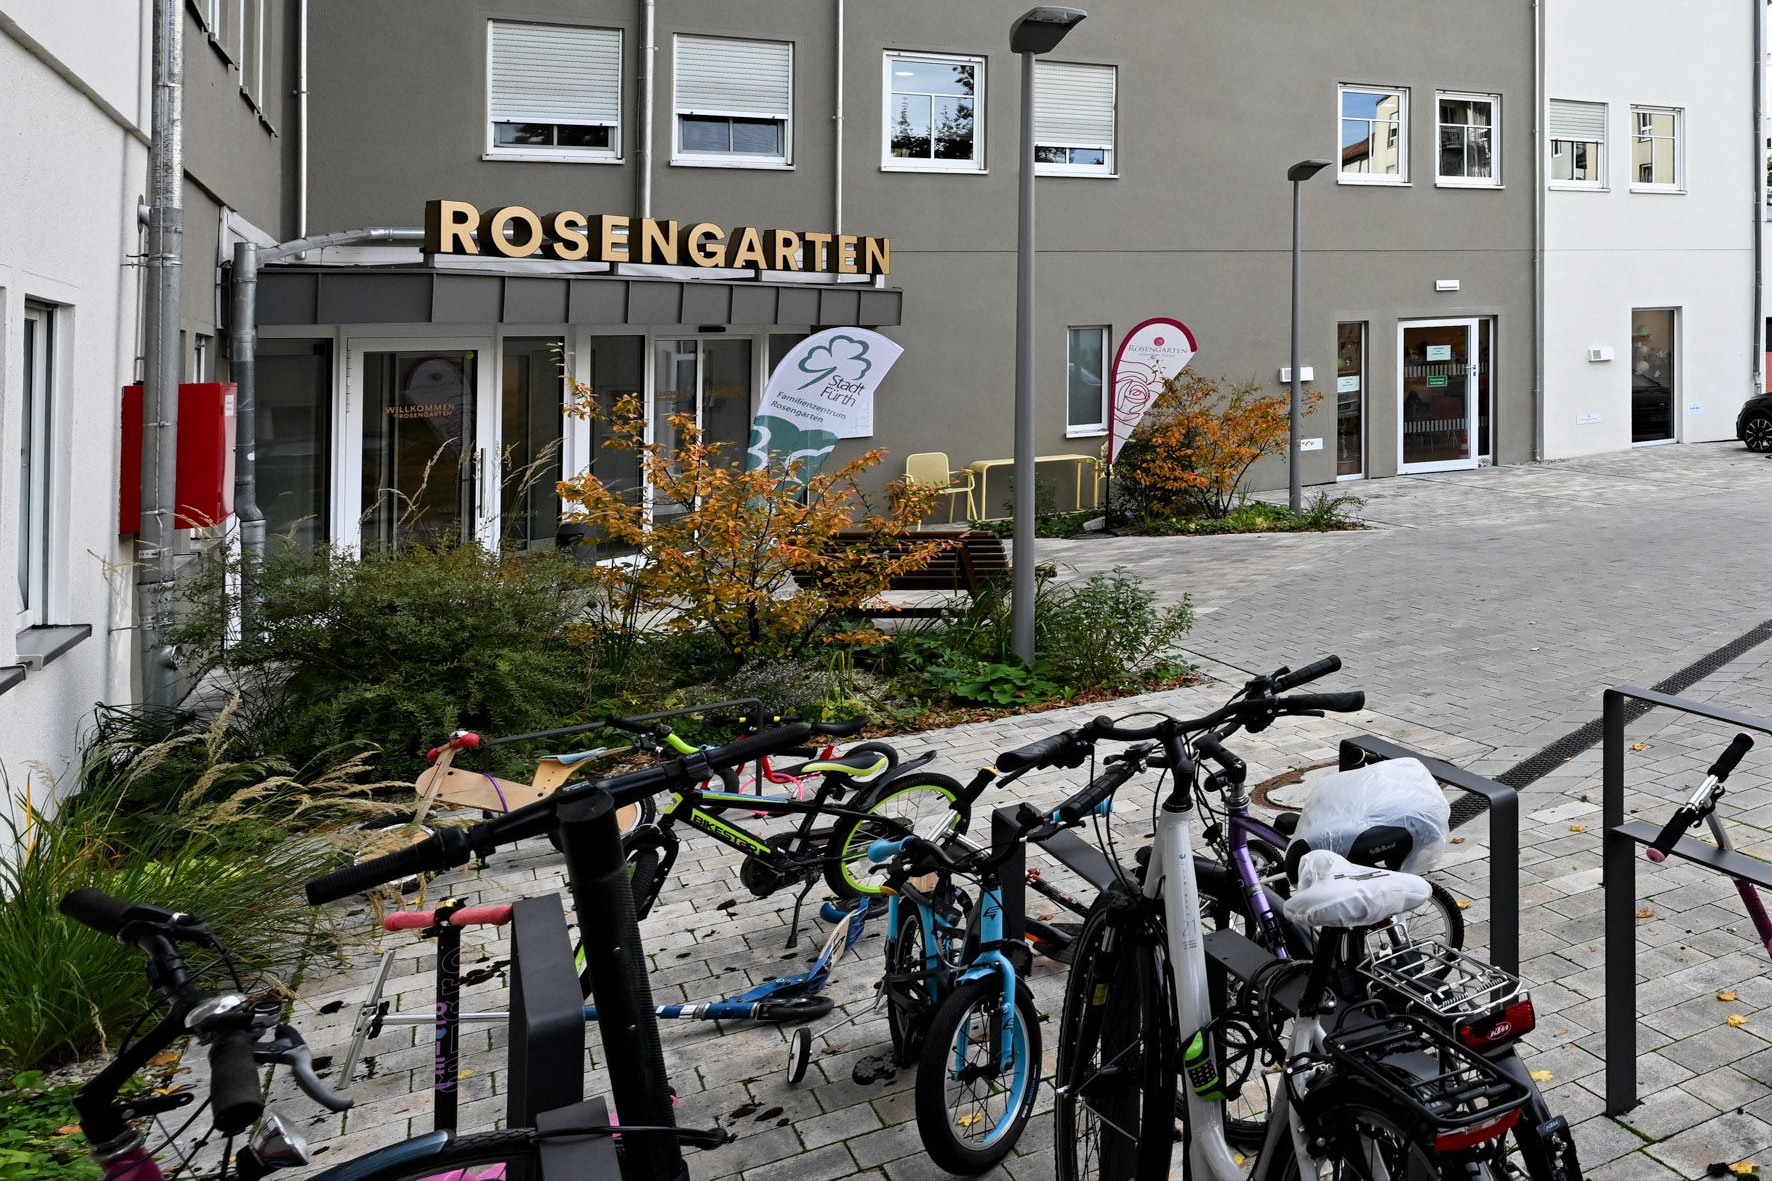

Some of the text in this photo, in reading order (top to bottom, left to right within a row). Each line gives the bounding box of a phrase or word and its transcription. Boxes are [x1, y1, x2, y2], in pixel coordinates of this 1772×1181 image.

[434, 199, 891, 275] ROSENGARTEN
[828, 374, 865, 396] Stadt
[776, 391, 847, 420] Familienzentrum
[820, 386, 857, 407] Fürth
[384, 402, 456, 415] WILLKOMMEN
[399, 410, 452, 419] ROSENGARTEN
[770, 400, 824, 423] Rosengarten
[1489, 1023, 1509, 1039] KTM
